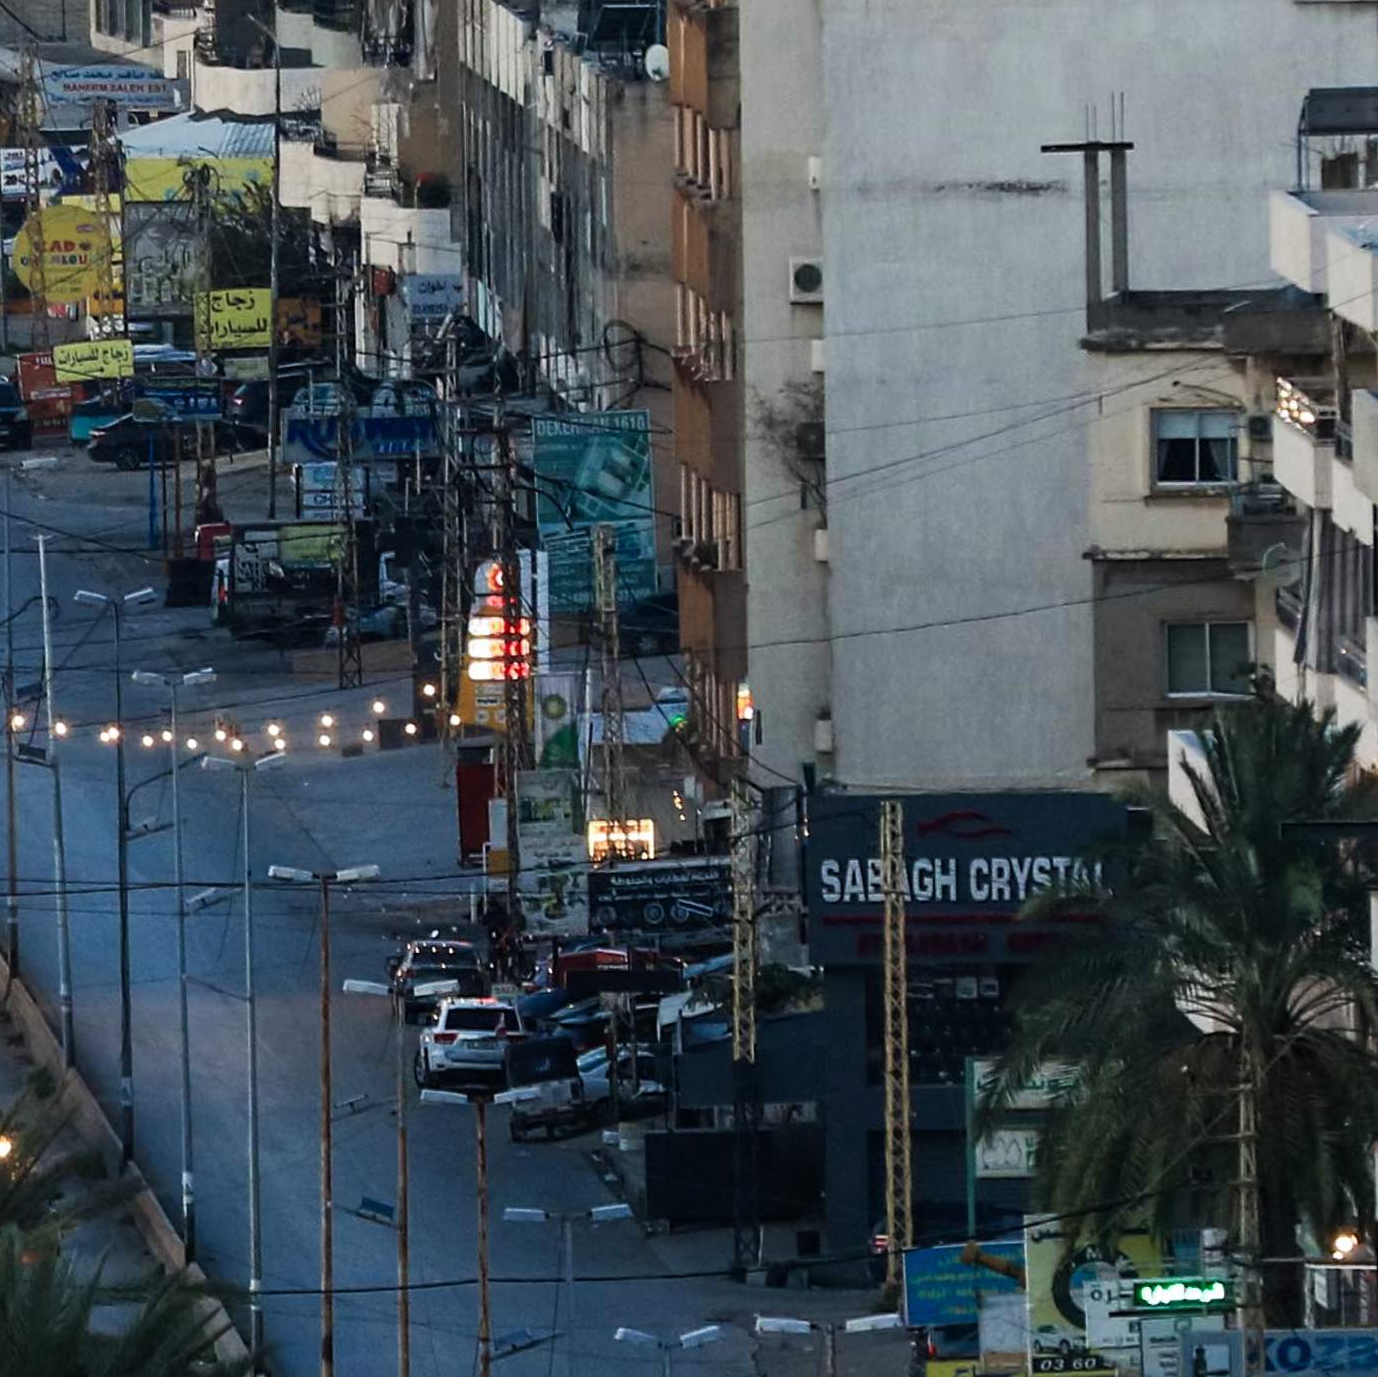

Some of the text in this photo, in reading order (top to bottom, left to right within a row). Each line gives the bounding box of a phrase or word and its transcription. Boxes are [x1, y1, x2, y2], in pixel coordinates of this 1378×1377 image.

[211, 290, 255, 313] زجاج
[57, 346, 99, 368] للسيارات
[102, 344, 130, 365] زجاج
[1040, 1359, 1065, 1372] 03
